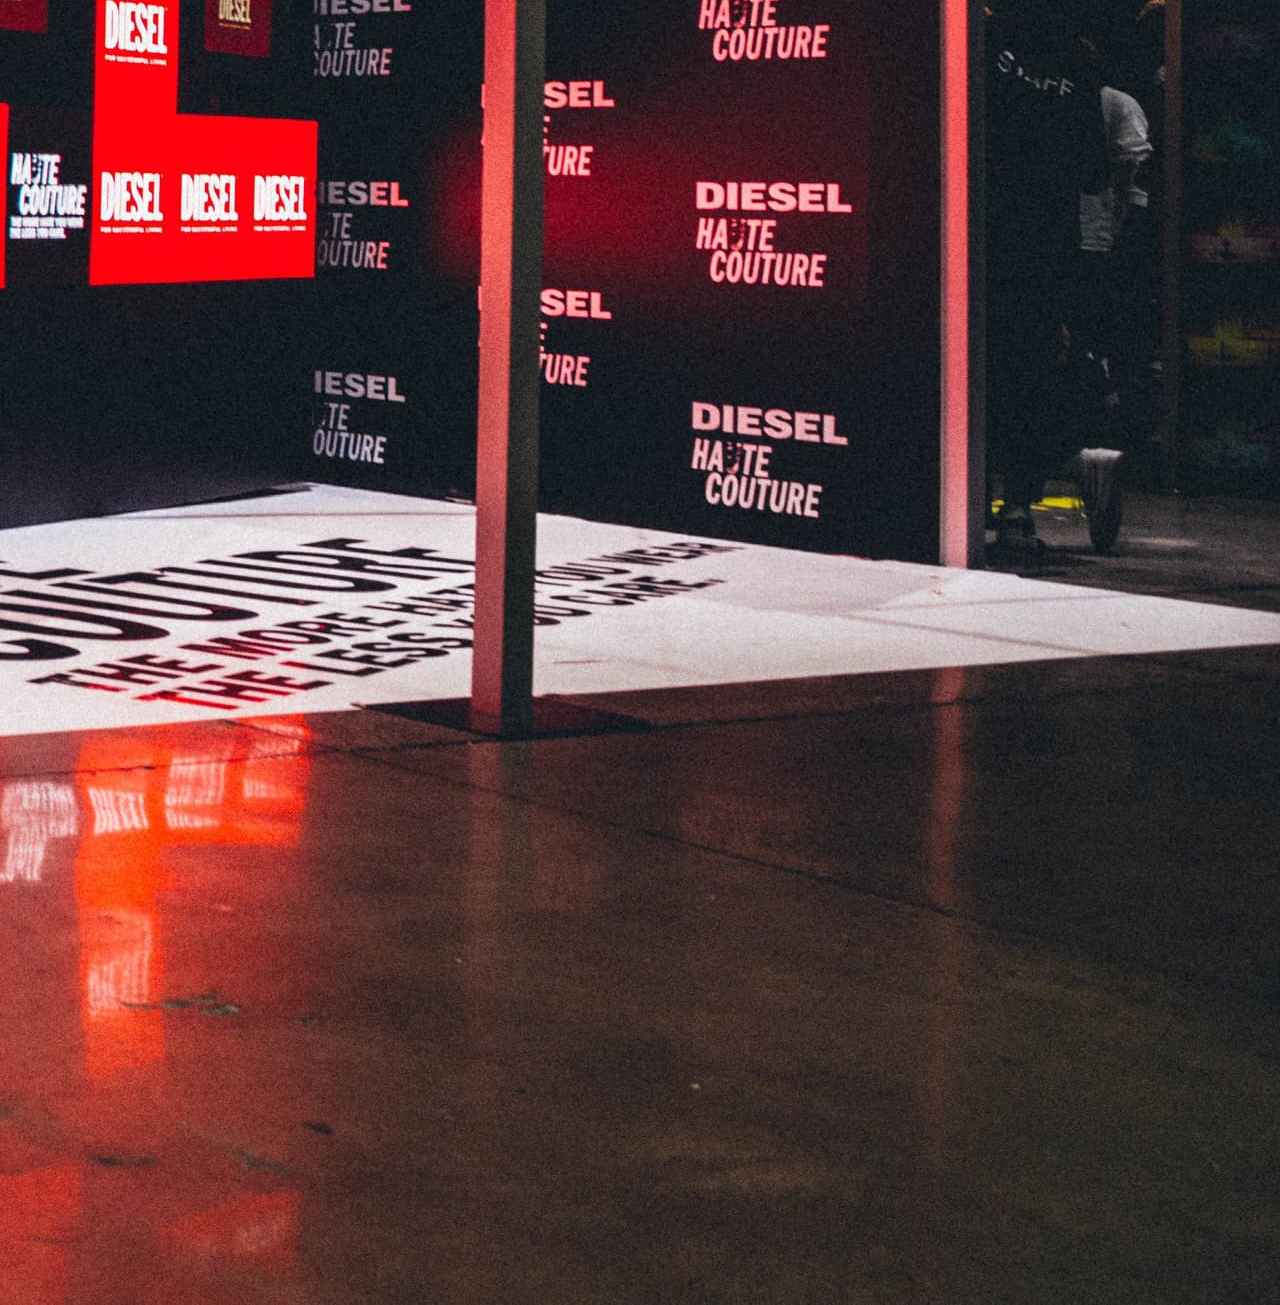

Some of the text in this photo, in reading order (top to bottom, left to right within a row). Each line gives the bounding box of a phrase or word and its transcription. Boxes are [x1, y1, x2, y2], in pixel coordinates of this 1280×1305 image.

[105, 0, 168, 54] DIESEL
[712, 24, 830, 62] COUTURE
[19, 183, 88, 216] COUTURE
[100, 171, 164, 223] DIESEL
[180, 173, 239, 222] DIESEL
[253, 174, 308, 222] DIESEL
[318, 181, 410, 207] IESEL
[696, 181, 853, 214] DIESEL
[318, 241, 391, 270] OUTURE
[709, 250, 828, 288] COUTURE
[314, 370, 407, 403] IESEL
[691, 401, 849, 446] DIESEL
[313, 429, 387, 465] OUTURE
[705, 471, 823, 519] COUTURE
[26, 653, 225, 693] THE
[178, 612, 409, 661] MORE
[128, 669, 334, 711] THE
[278, 632, 474, 677] LESS
